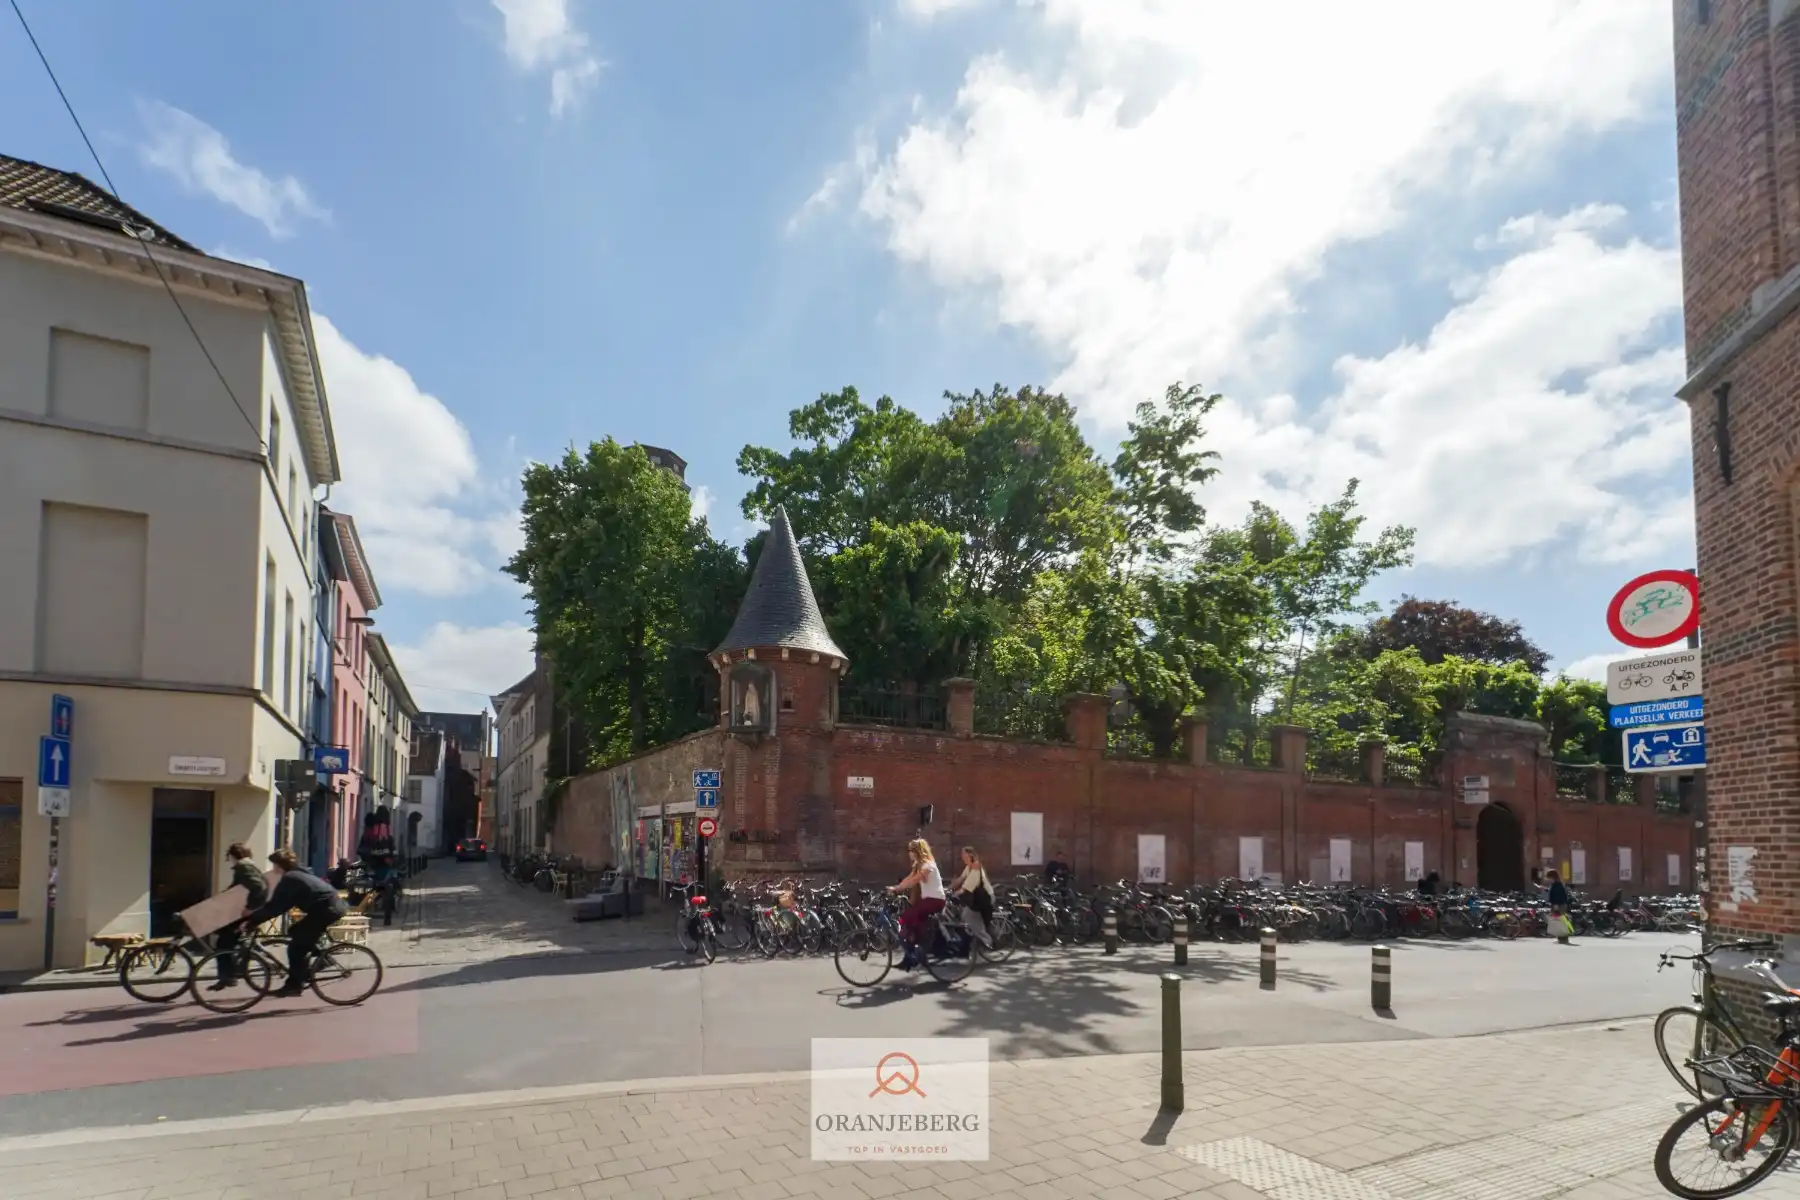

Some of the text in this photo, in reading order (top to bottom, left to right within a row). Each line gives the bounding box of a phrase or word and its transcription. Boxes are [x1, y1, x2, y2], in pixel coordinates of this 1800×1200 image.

[1618, 655, 1695, 672] UITGEZONDERD
[1629, 700, 1689, 714] UITGEZONDERD
[1614, 713, 1665, 725] PLAATSELIJK
